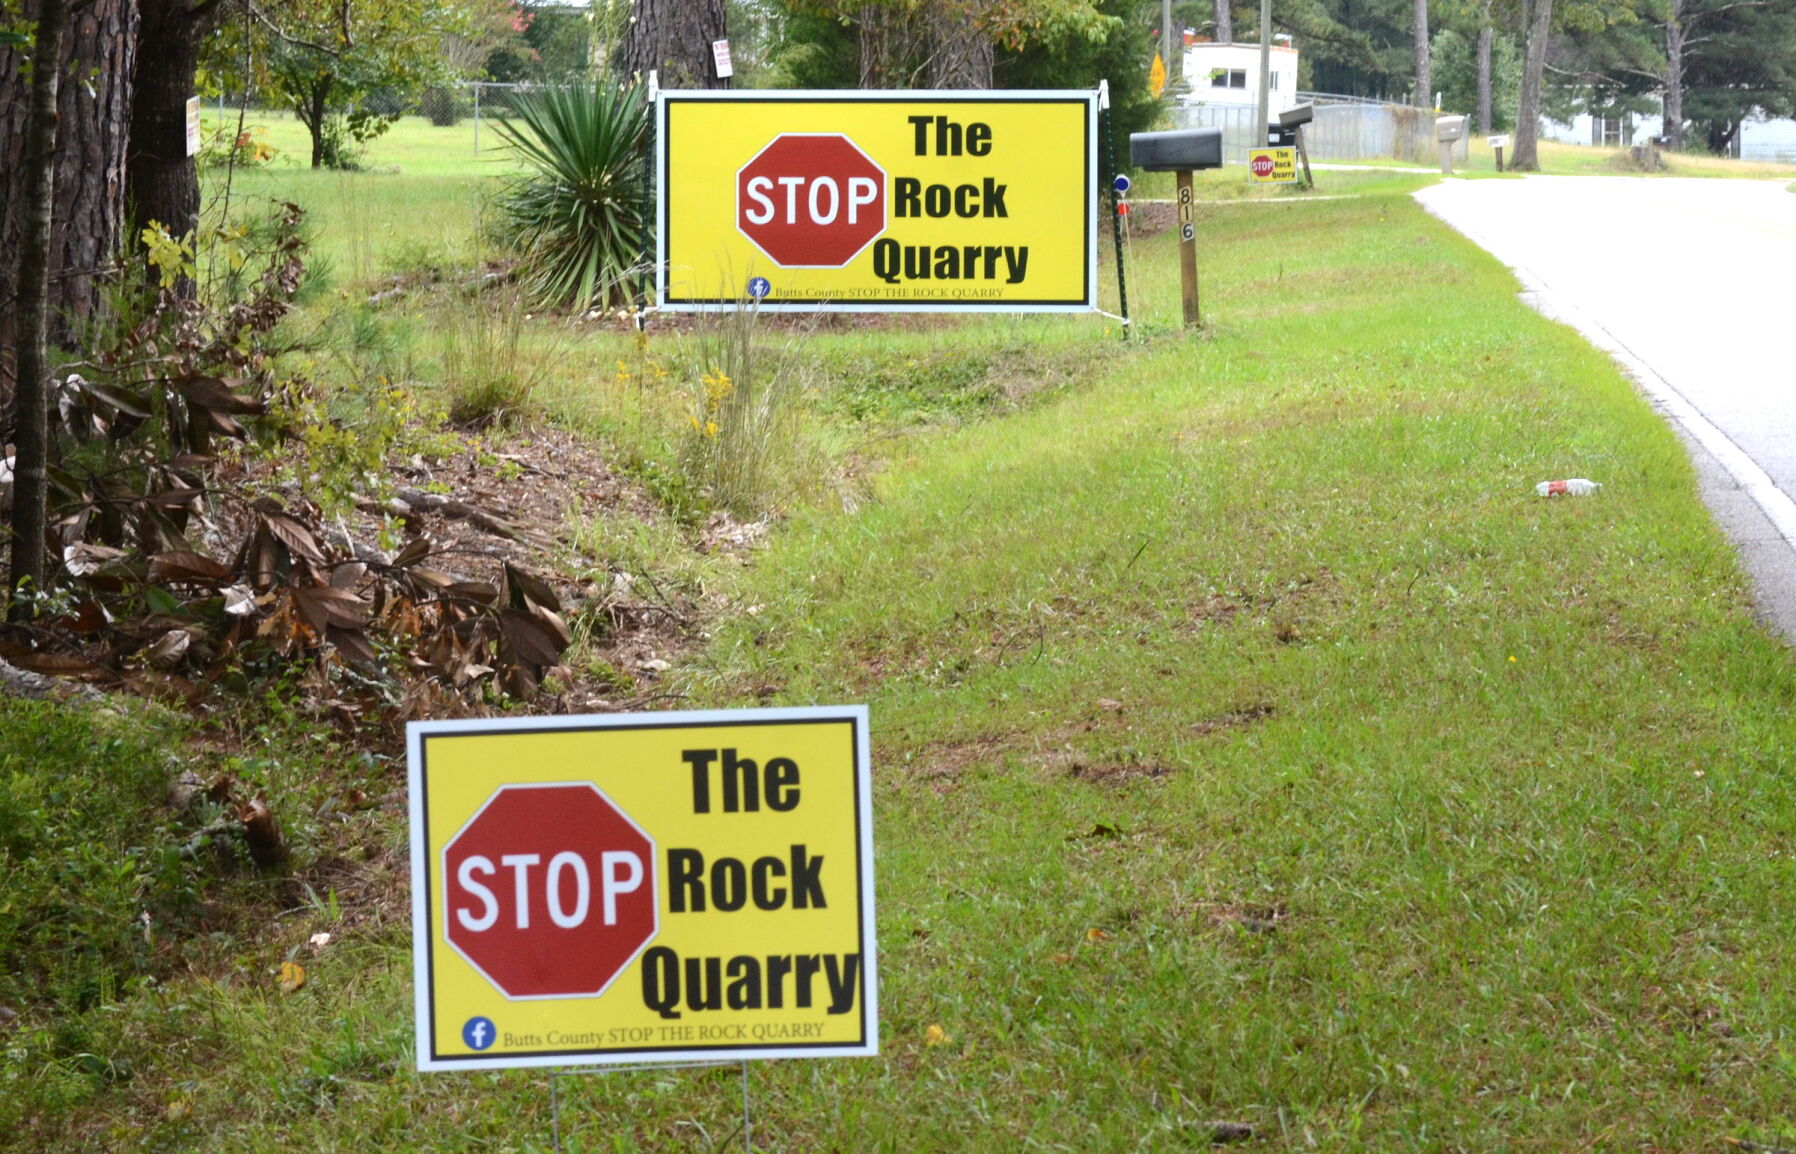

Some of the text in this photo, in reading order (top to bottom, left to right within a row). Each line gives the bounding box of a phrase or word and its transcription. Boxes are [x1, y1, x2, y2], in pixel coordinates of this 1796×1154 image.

[907, 115, 992, 157] The
[1252, 161, 1273, 171] STOP
[1272, 171, 1295, 179] Quarry
[745, 175, 878, 225] STOP
[893, 177, 1008, 219] Rock
[1180, 188, 1194, 239] 816
[872, 237, 1029, 285] Quarry
[775, 287, 1005, 300] Butts County STOP THE ROCK QUARRY
[681, 747, 801, 815] The
[456, 850, 645, 933] STOP
[666, 844, 828, 914] Rock
[641, 945, 859, 1020] Quarry
[503, 1022, 825, 1049] Butts County STOP THE ROCK QUARRY
